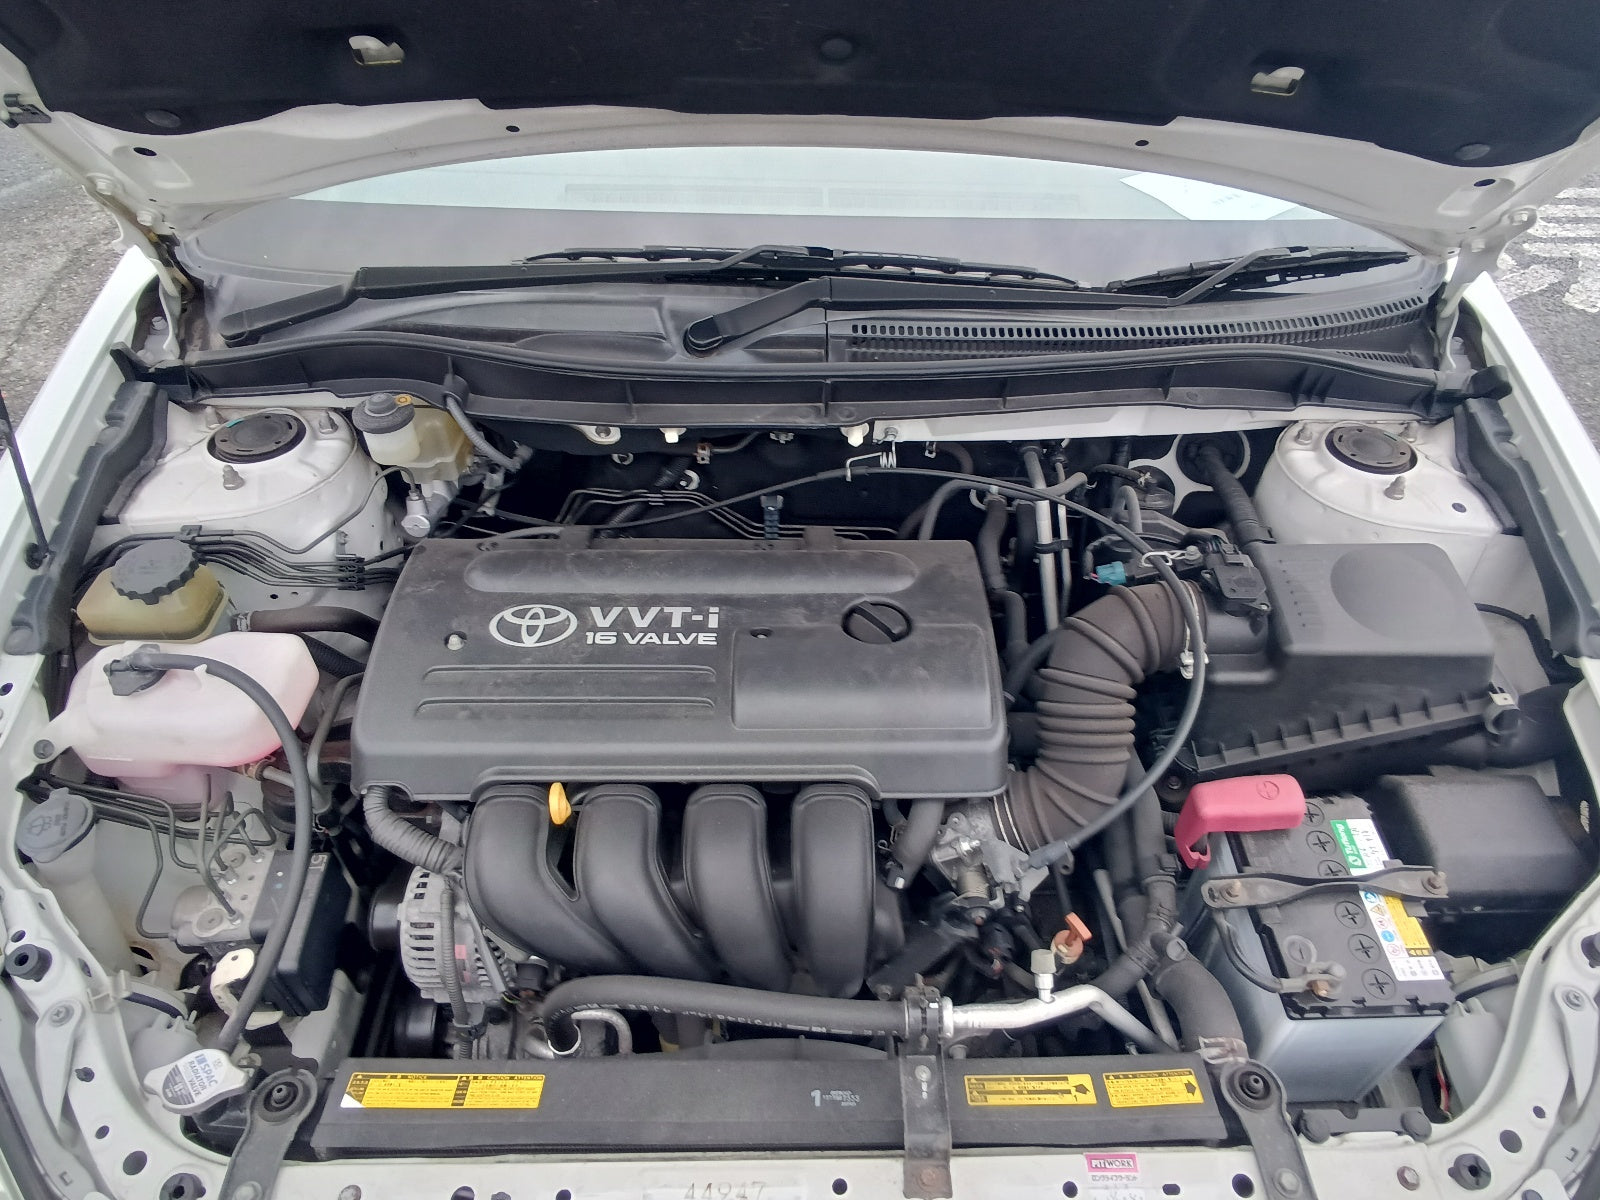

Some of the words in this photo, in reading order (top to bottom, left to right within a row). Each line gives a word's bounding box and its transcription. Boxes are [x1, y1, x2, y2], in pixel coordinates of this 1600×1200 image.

[590, 606, 720, 628] VVT-i
[586, 632, 617, 645] 16
[623, 632, 718, 645] VALVE
[188, 1060, 208, 1091] RADIATOR
